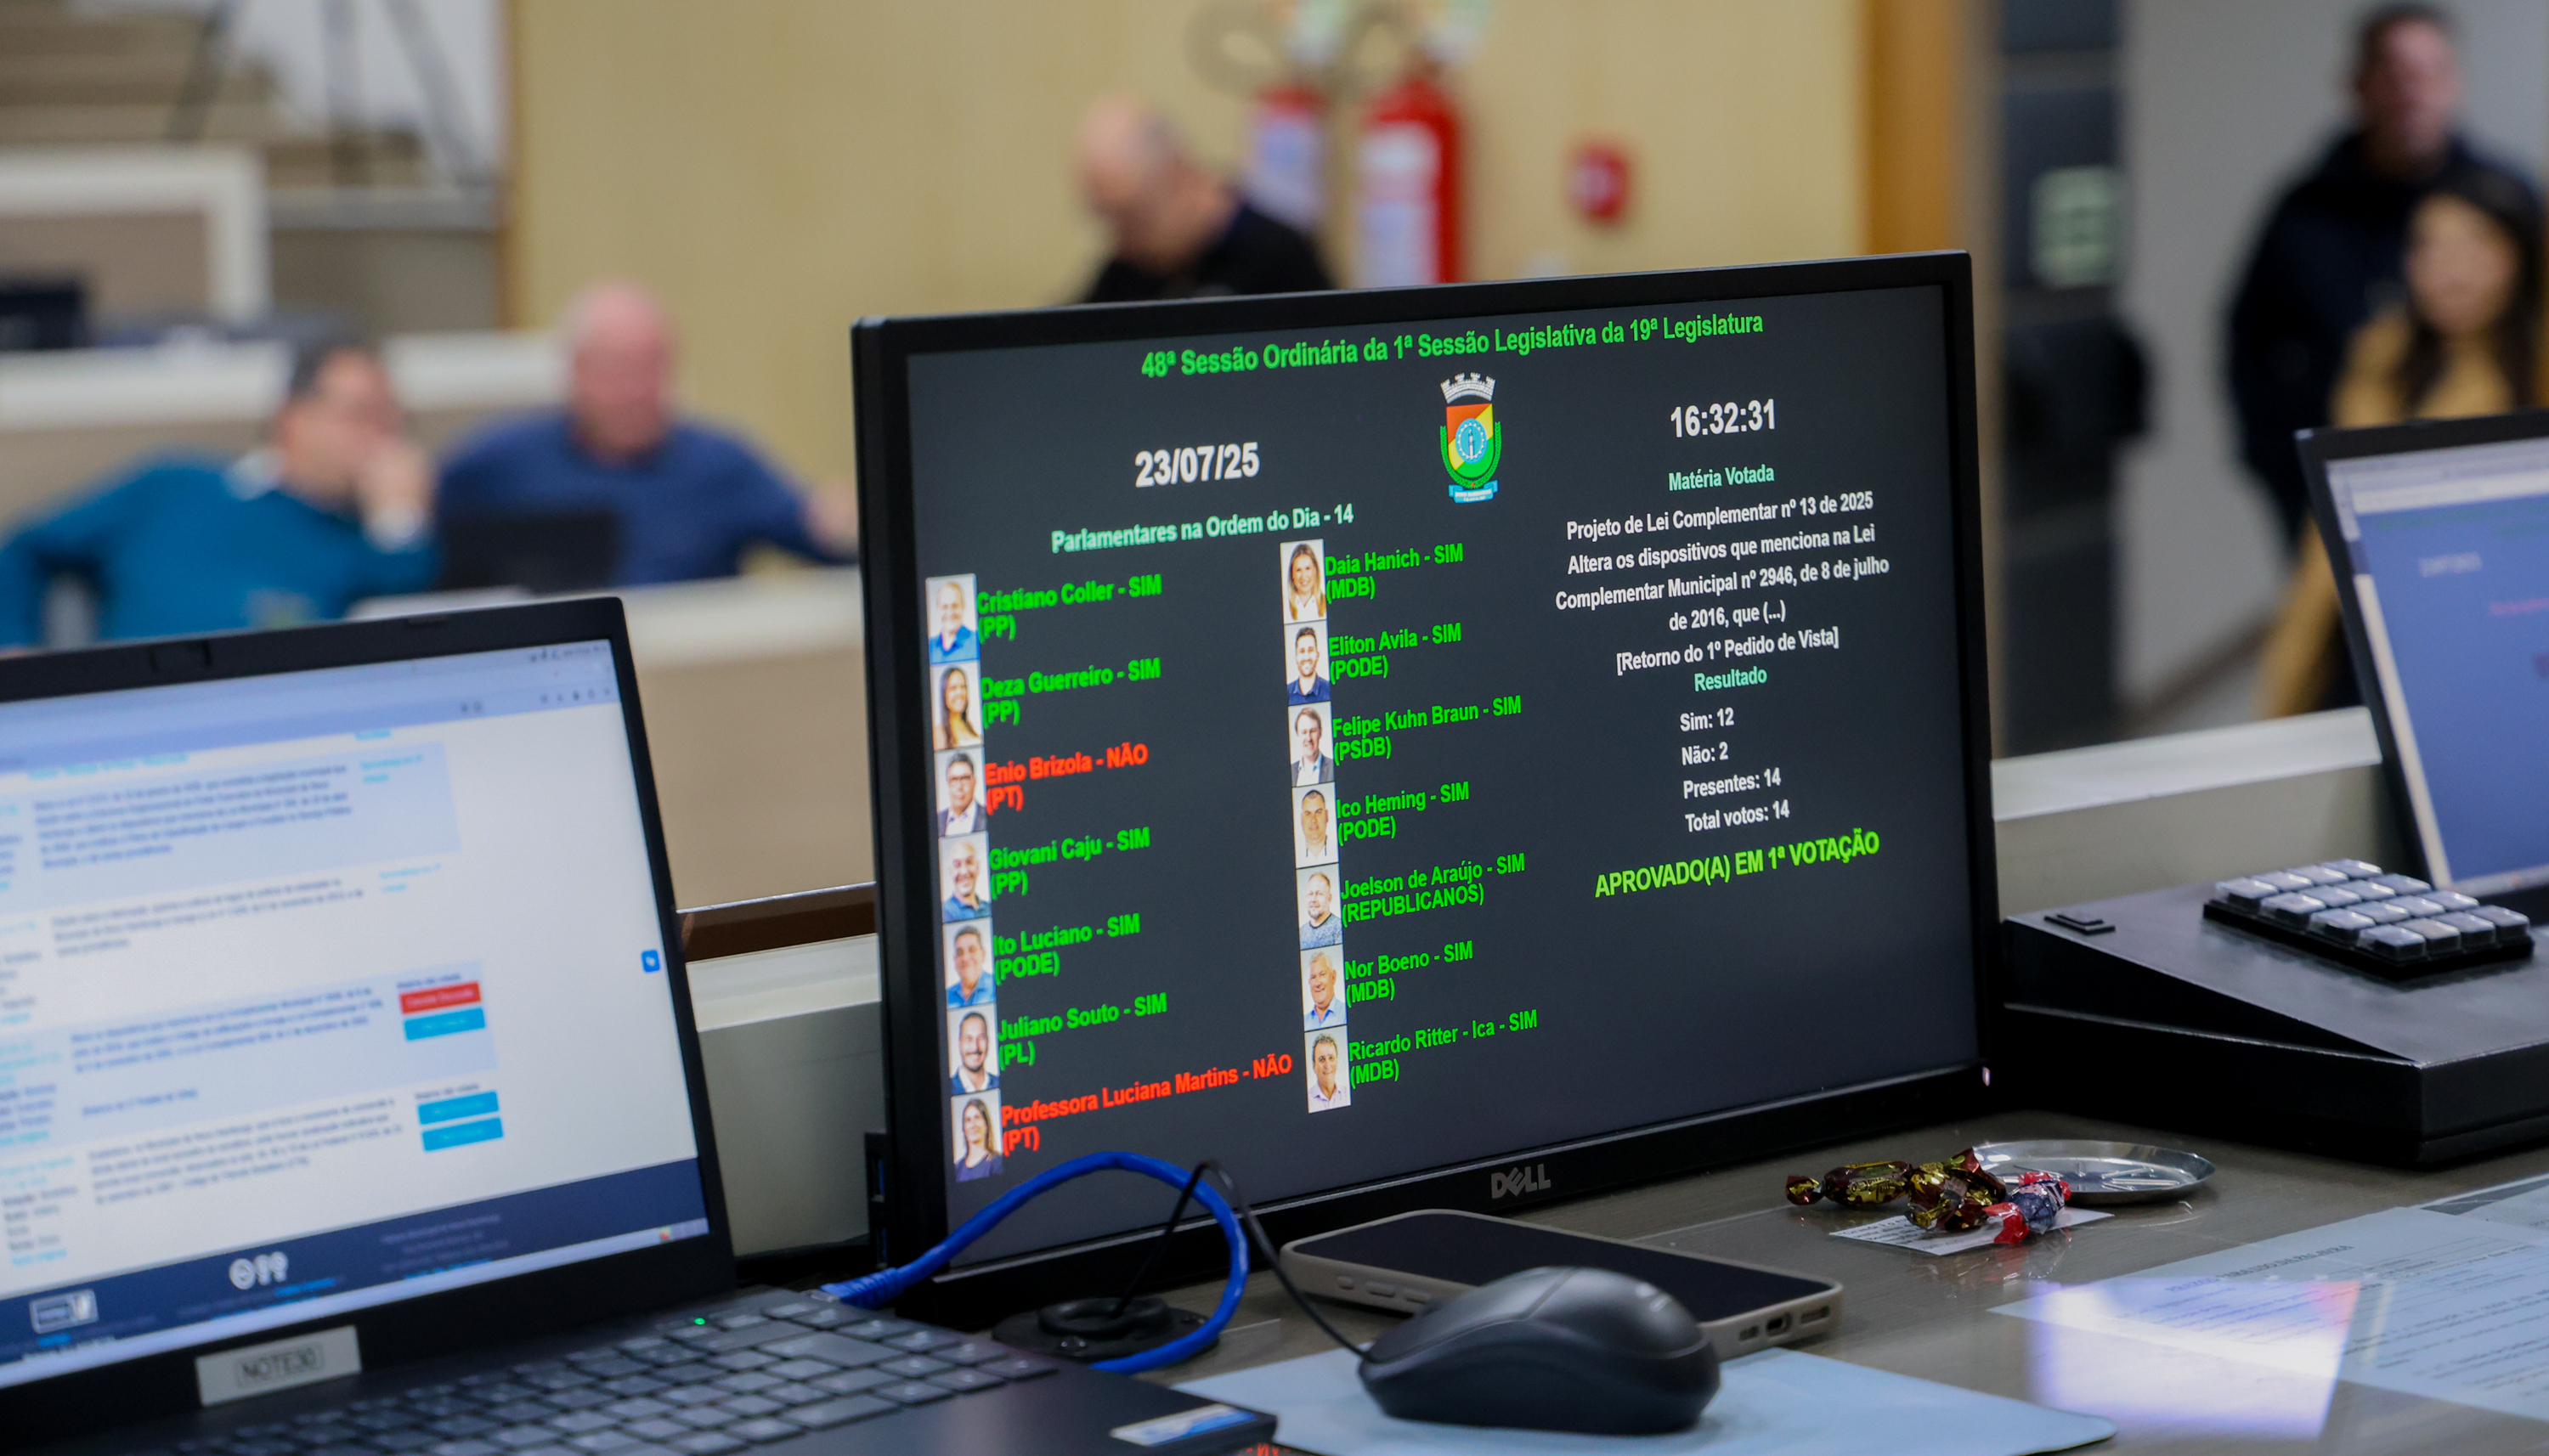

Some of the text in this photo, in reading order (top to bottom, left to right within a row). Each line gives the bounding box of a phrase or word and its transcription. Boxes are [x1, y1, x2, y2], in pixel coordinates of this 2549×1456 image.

[1141, 313, 1763, 377] 48ª Sessão Ordinária da 1ª Sessão Legislativa da 19ª Legislatura
[1670, 399, 1775, 437] 16:32:31
[1135, 443, 1260, 487] 23/07/25
[1669, 464, 1774, 491] Matéria Votada
[1051, 524, 1178, 553] Parlamentares
[1181, 522, 1203, 540] na
[1206, 514, 1263, 537] Ordem
[1266, 510, 1290, 531] do
[1292, 507, 1320, 528] Dia
[1334, 503, 1354, 524] 14
[1567, 491, 1873, 542] Projeto de Lei Complementar nº 13 de 2025
[1325, 555, 1360, 575] Daia
[1365, 548, 1420, 572] Hanich
[1434, 544, 1463, 563] SIM
[1568, 523, 1874, 574] Altera os dispositivos que menciona na Lei
[978, 589, 1058, 612] Cristiano
[1061, 581, 1113, 604] Coller
[1129, 574, 1161, 596] SIM
[1326, 577, 1375, 603] (MDB)
[1556, 556, 1889, 610] Complementar Municipal nº 2946, de 8 de julho
[979, 616, 1015, 641] (PP)
[1669, 600, 1786, 630] de 2016, que (...)
[1329, 635, 1375, 657] Eliton
[1379, 629, 1417, 650] Avila
[1432, 623, 1461, 643] SIM
[1617, 626, 1839, 675] [Retorno do 1º Pedido de Vista]
[981, 678, 1024, 698] Deza
[1029, 665, 1113, 692] Guerreiro
[1128, 658, 1160, 680] SIM
[1330, 655, 1388, 684] (PODE)
[1694, 666, 1767, 691] Resultado
[983, 701, 1020, 727] (PP)
[1332, 715, 1384, 737] Felipe
[1385, 709, 1427, 732] Kuhn
[1432, 706, 1478, 725] Braun
[1493, 695, 1521, 716] SIM
[1680, 707, 1734, 731] Sim: 12
[985, 761, 1027, 786] Enio
[1029, 752, 1093, 779] Brizola
[1106, 742, 1148, 769] NÃO
[1334, 736, 1391, 765] (PSDB)
[1681, 742, 1728, 765] Não: 2
[986, 785, 1023, 814] (PT)
[1337, 799, 1363, 817] Ico
[1365, 790, 1427, 816] Heming
[1440, 782, 1469, 803] SIM
[1683, 767, 1781, 799] Presentes: 14
[1338, 815, 1395, 846] (PODE)
[1685, 799, 1789, 832] Total votos: 14
[989, 840, 1059, 871] Giovani
[1061, 835, 1102, 861] Caju
[1117, 827, 1150, 850] SIM
[1595, 827, 1879, 897] APROVADO(A) EM 1ª VOTAÇÃO
[991, 871, 1027, 899] (PP)
[1341, 877, 1404, 900] Joelson
[1405, 870, 1430, 889] de
[1431, 861, 1484, 888] Araújo
[1496, 853, 1524, 874] SIM
[1342, 883, 1484, 927] (REPUBLICANOS)
[993, 935, 1017, 956] Ito
[1020, 926, 1092, 951] Luciano
[1107, 913, 1140, 937] SIM
[995, 952, 1060, 985] (PODE)
[1345, 960, 1374, 979] Nor
[1378, 953, 1429, 974] Boeno
[1444, 940, 1472, 962] SIM
[1346, 978, 1394, 1007] (MDB)
[998, 1016, 1063, 1041] Juliano
[1066, 1005, 1119, 1028] Souto
[1134, 992, 1167, 1016] SIM
[1349, 1034, 1410, 1061] Ricardo
[1415, 1028, 1458, 1048] Ritter
[1472, 1020, 1495, 1038] Ica
[1509, 1009, 1537, 1031] SIM
[998, 1041, 1035, 1069] (PL)
[1002, 1094, 1099, 1126] Professora
[1102, 1081, 1172, 1108] Luciana
[1175, 1067, 1239, 1094] Martins
[1252, 1053, 1292, 1079] NÃO
[1350, 1058, 1399, 1089] (MDB)
[1003, 1126, 1039, 1156] (PT)
[1490, 1163, 1551, 1199] DELL
